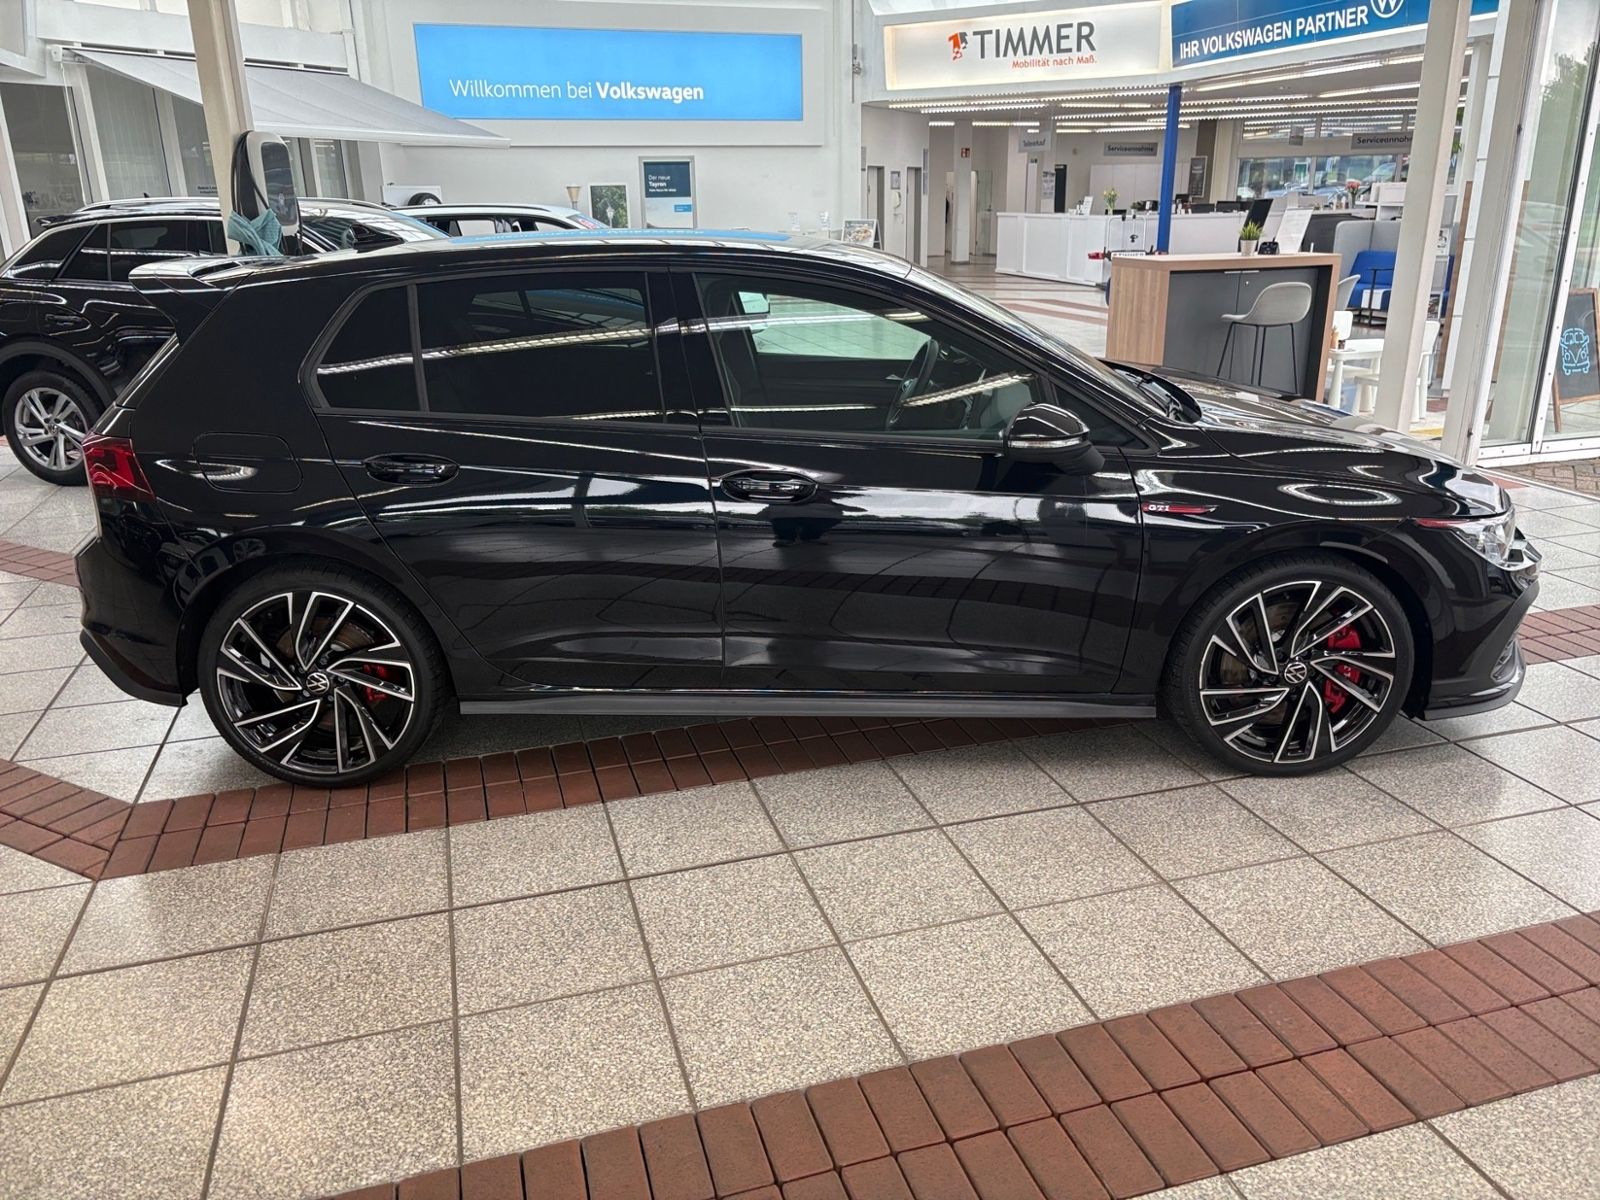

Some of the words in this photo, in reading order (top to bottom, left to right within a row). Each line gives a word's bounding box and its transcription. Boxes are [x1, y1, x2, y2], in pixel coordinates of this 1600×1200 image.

[973, 21, 1096, 59] TIMMER
[1180, 40, 1200, 59] IHR
[1201, 20, 1292, 55] VOLKSWAGEN
[1296, 6, 1369, 37] PARTNER
[1012, 57, 1050, 69] Mobilität
[1052, 56, 1074, 66] nach
[1076, 54, 1098, 65] Maß.
[449, 79, 561, 99] Willkommen
[567, 81, 593, 99] bei
[596, 81, 704, 104] Volkswagen
[1357, 135, 1413, 144] Serviceannah
